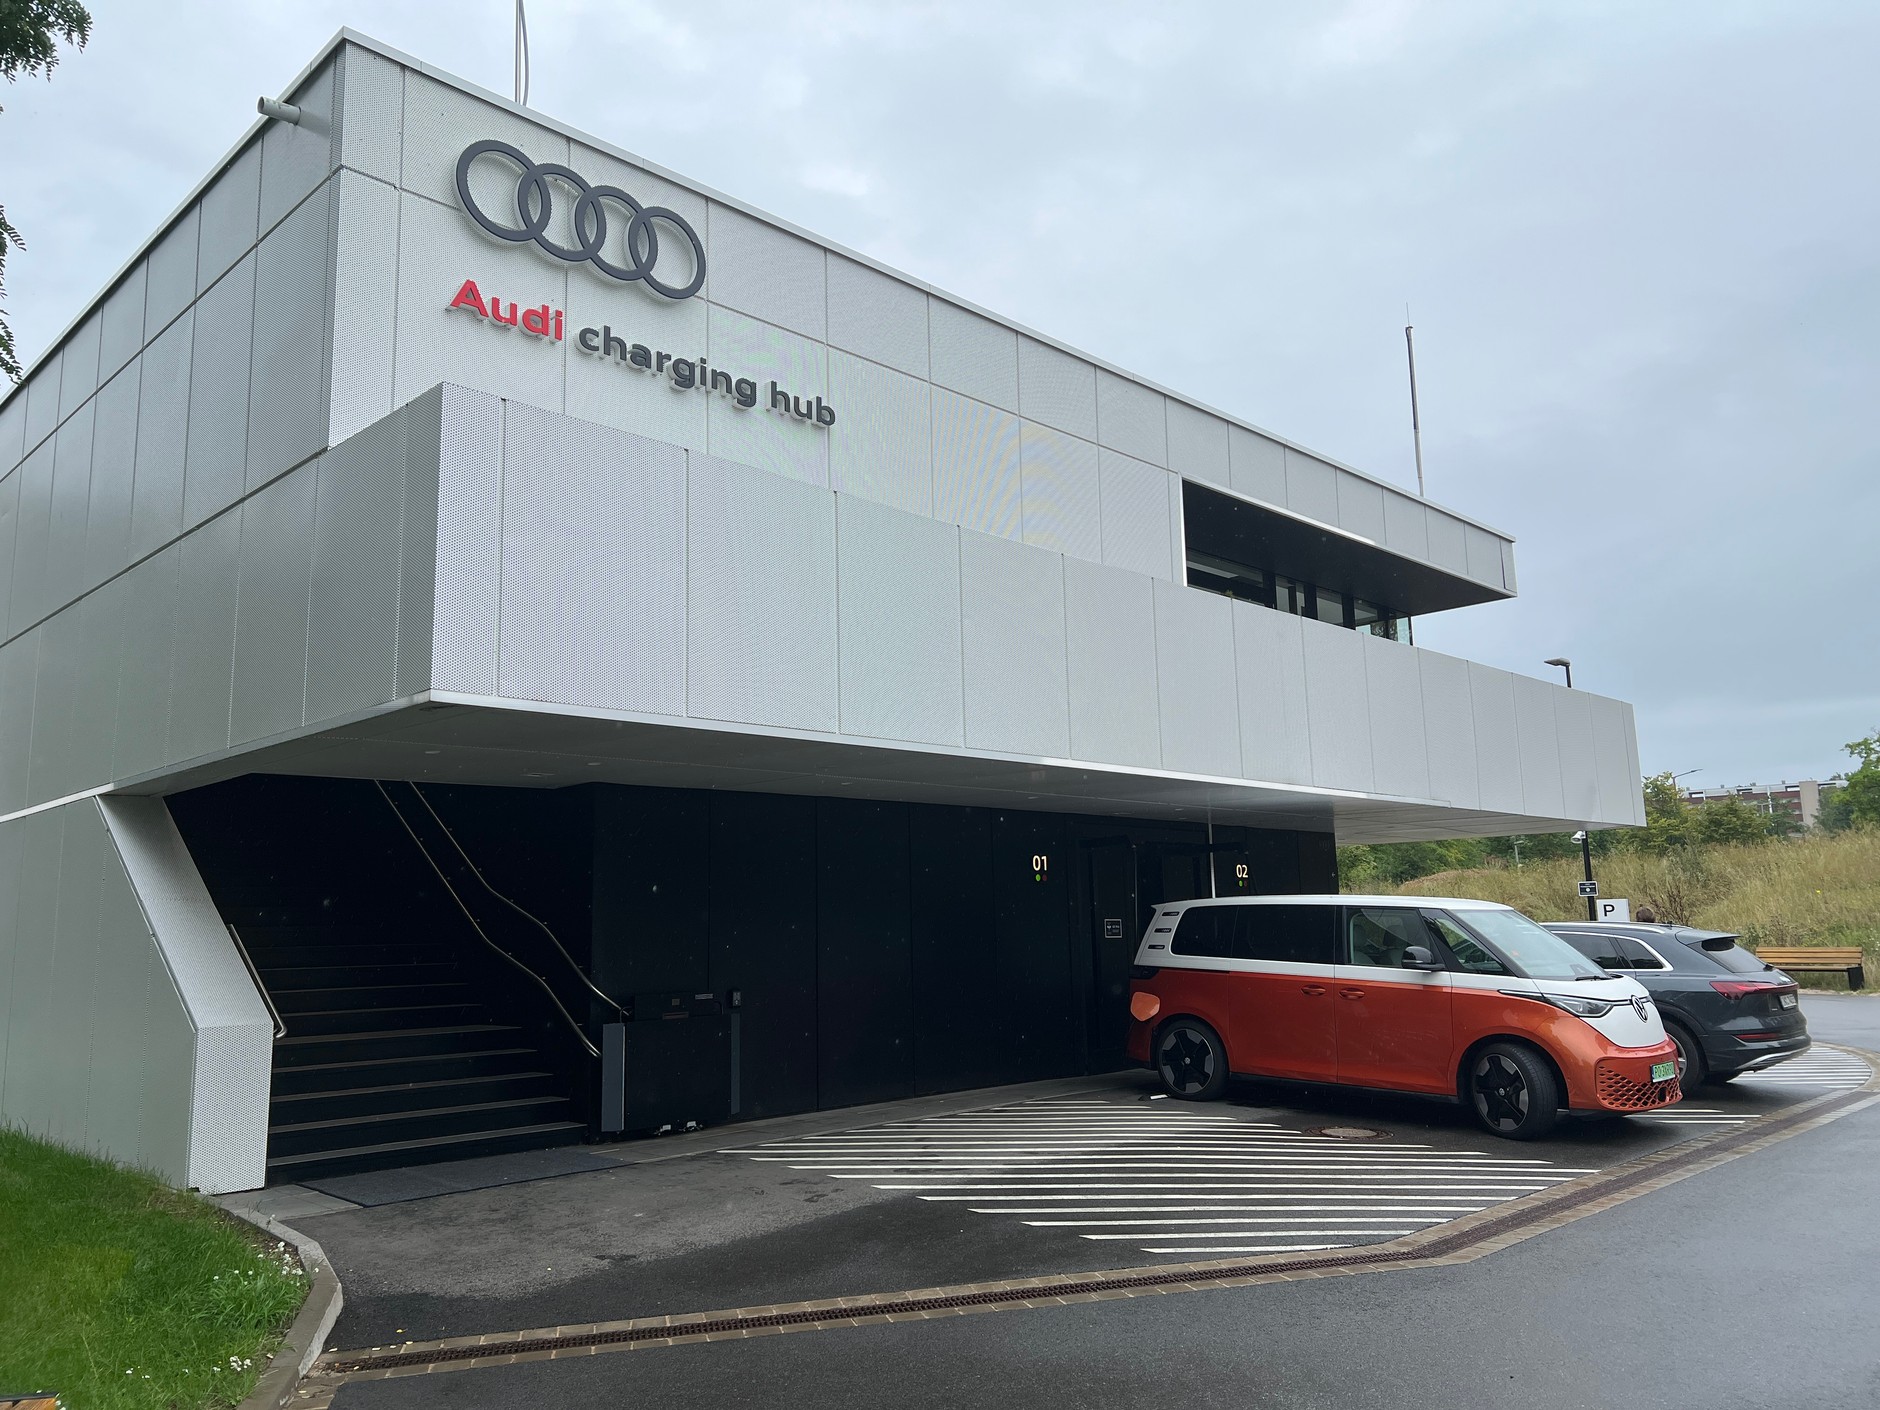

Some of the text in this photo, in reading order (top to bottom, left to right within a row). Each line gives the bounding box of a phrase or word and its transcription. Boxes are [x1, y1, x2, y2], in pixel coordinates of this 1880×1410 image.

[448, 279, 836, 427] Audi charging hub
[1032, 855, 1048, 871] 01
[1236, 864, 1249, 878] 02
[1603, 904, 1615, 917] P
